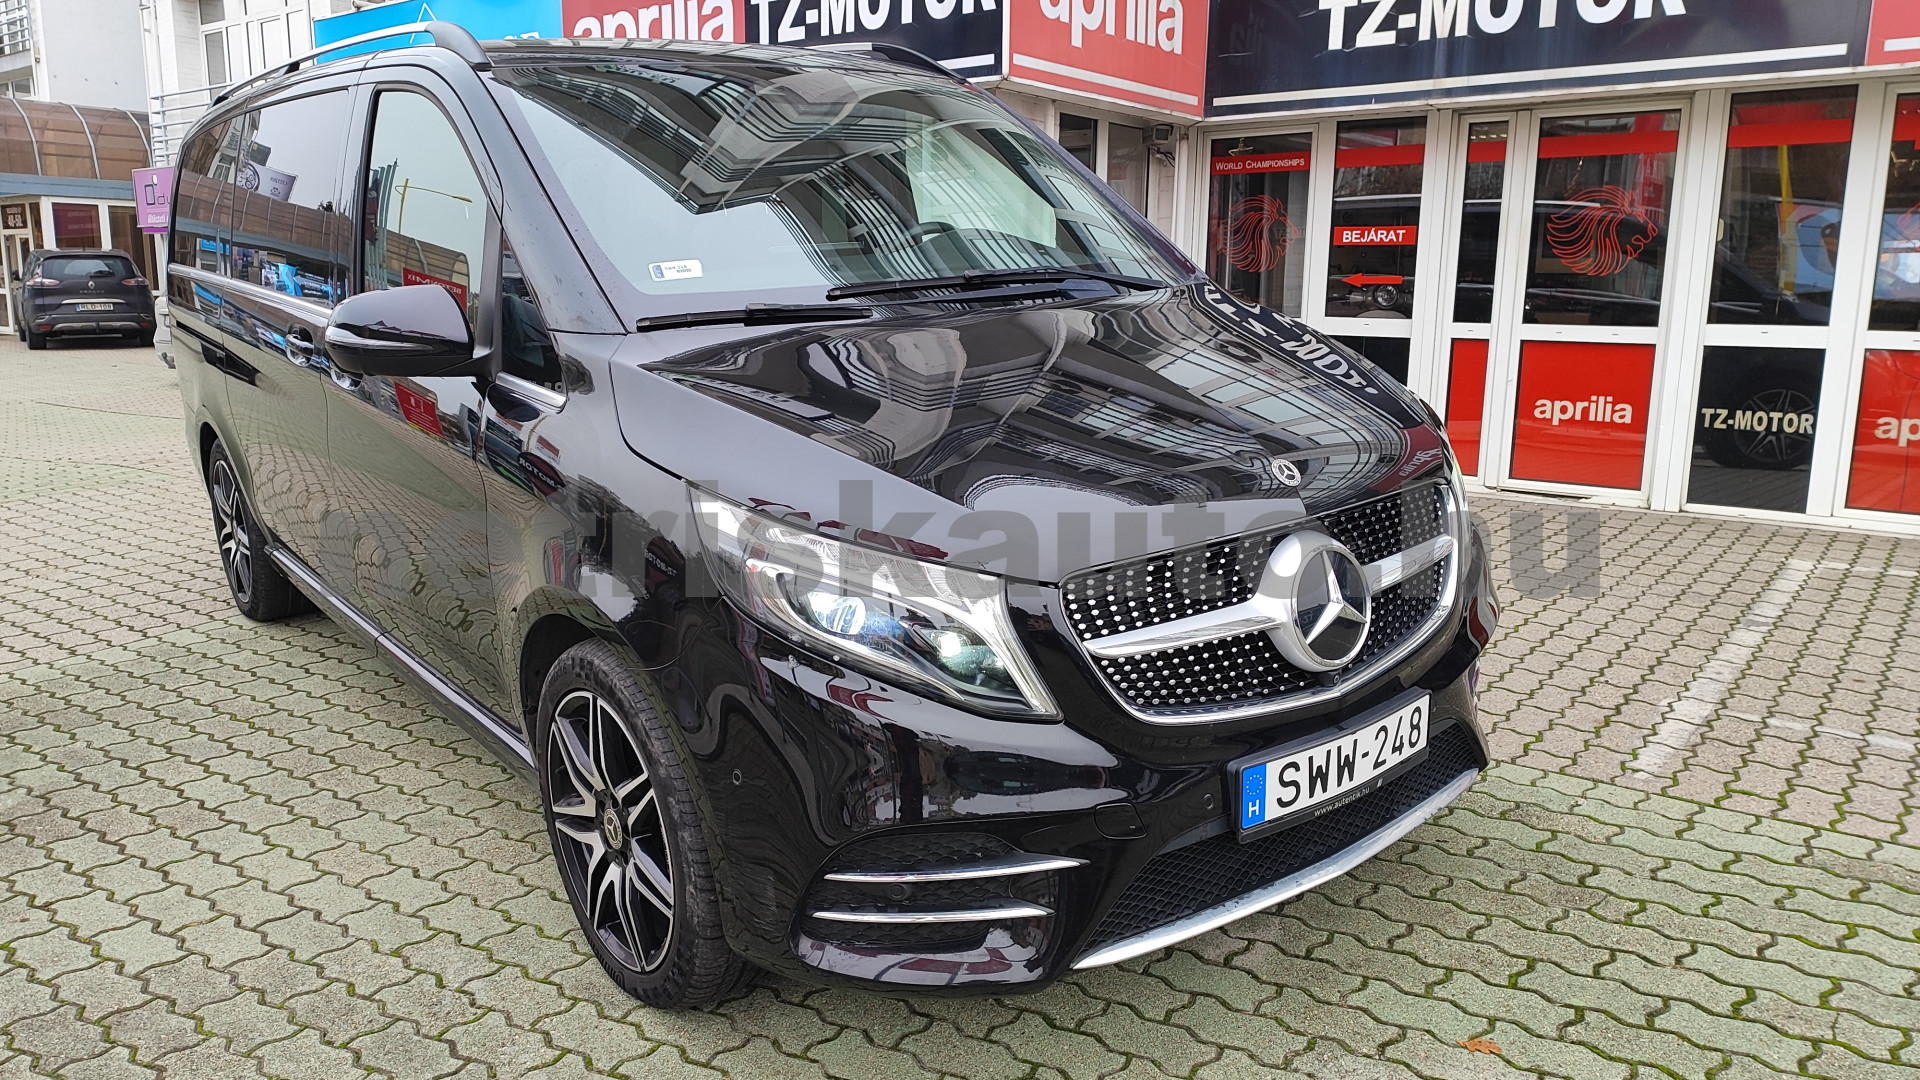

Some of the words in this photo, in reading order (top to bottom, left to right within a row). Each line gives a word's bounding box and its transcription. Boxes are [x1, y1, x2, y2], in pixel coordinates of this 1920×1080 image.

[749, 0, 996, 44] TZ-MOT
[1342, 227, 1406, 243] BEJÁRAT
[1533, 395, 1633, 425] aprilia
[1700, 408, 1815, 434] TZ-MOTOR
[1276, 705, 1423, 809] SWW-248
[1248, 799, 1260, 818] H
[1314, 786, 1370, 817] www.autentik.hu
